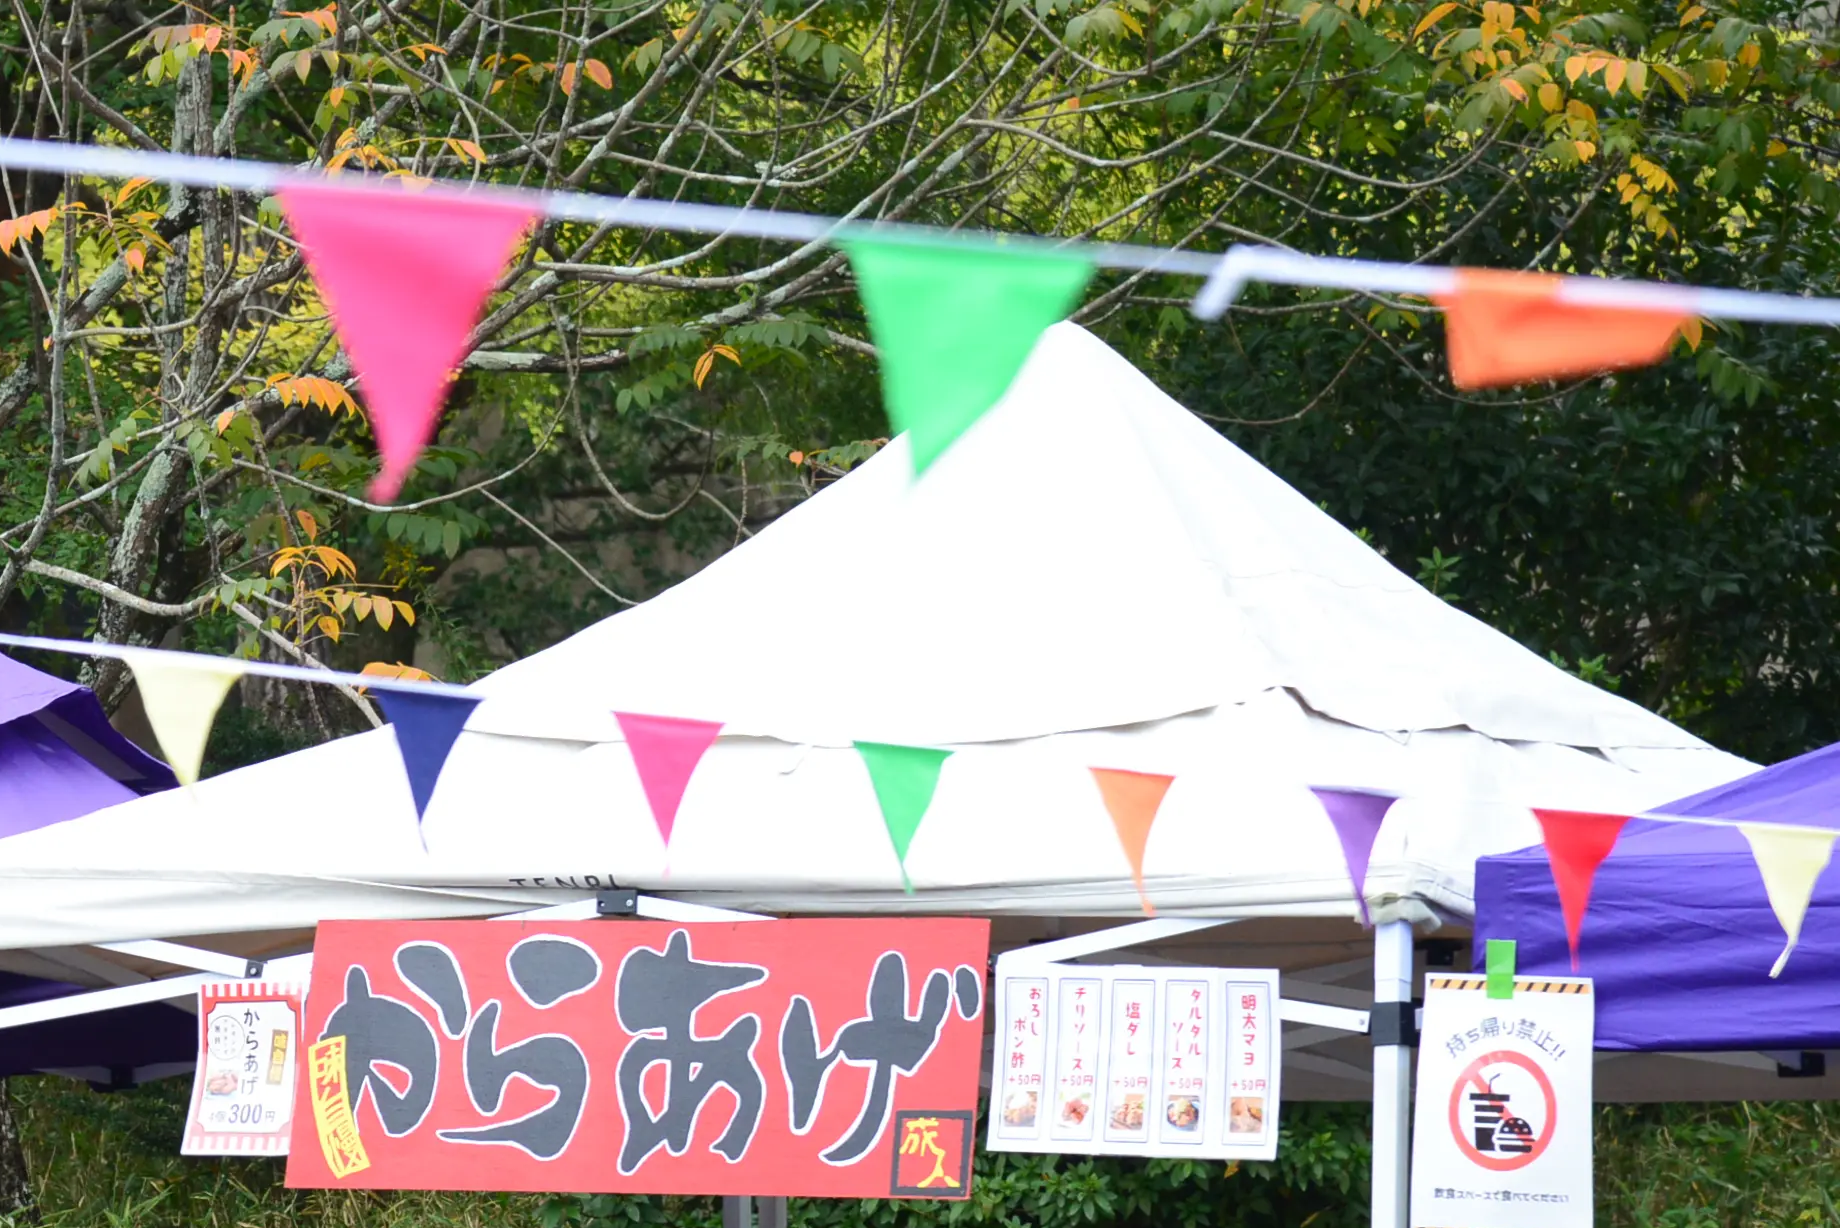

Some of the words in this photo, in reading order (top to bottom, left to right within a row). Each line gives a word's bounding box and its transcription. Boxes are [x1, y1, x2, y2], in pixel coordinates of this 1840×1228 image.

[1011, 1017, 1026, 1069] ポン酢
[1029, 987, 1041, 1037] おろし
[1072, 986, 1086, 1070] チリソース
[1171, 1021, 1184, 1070] ソース
[1188, 988, 1202, 1056] タルタル
[1241, 994, 1257, 1066] 明太マヨ
[241, 1008, 260, 1095] からあげ
[318, 927, 980, 1176] からあげ
